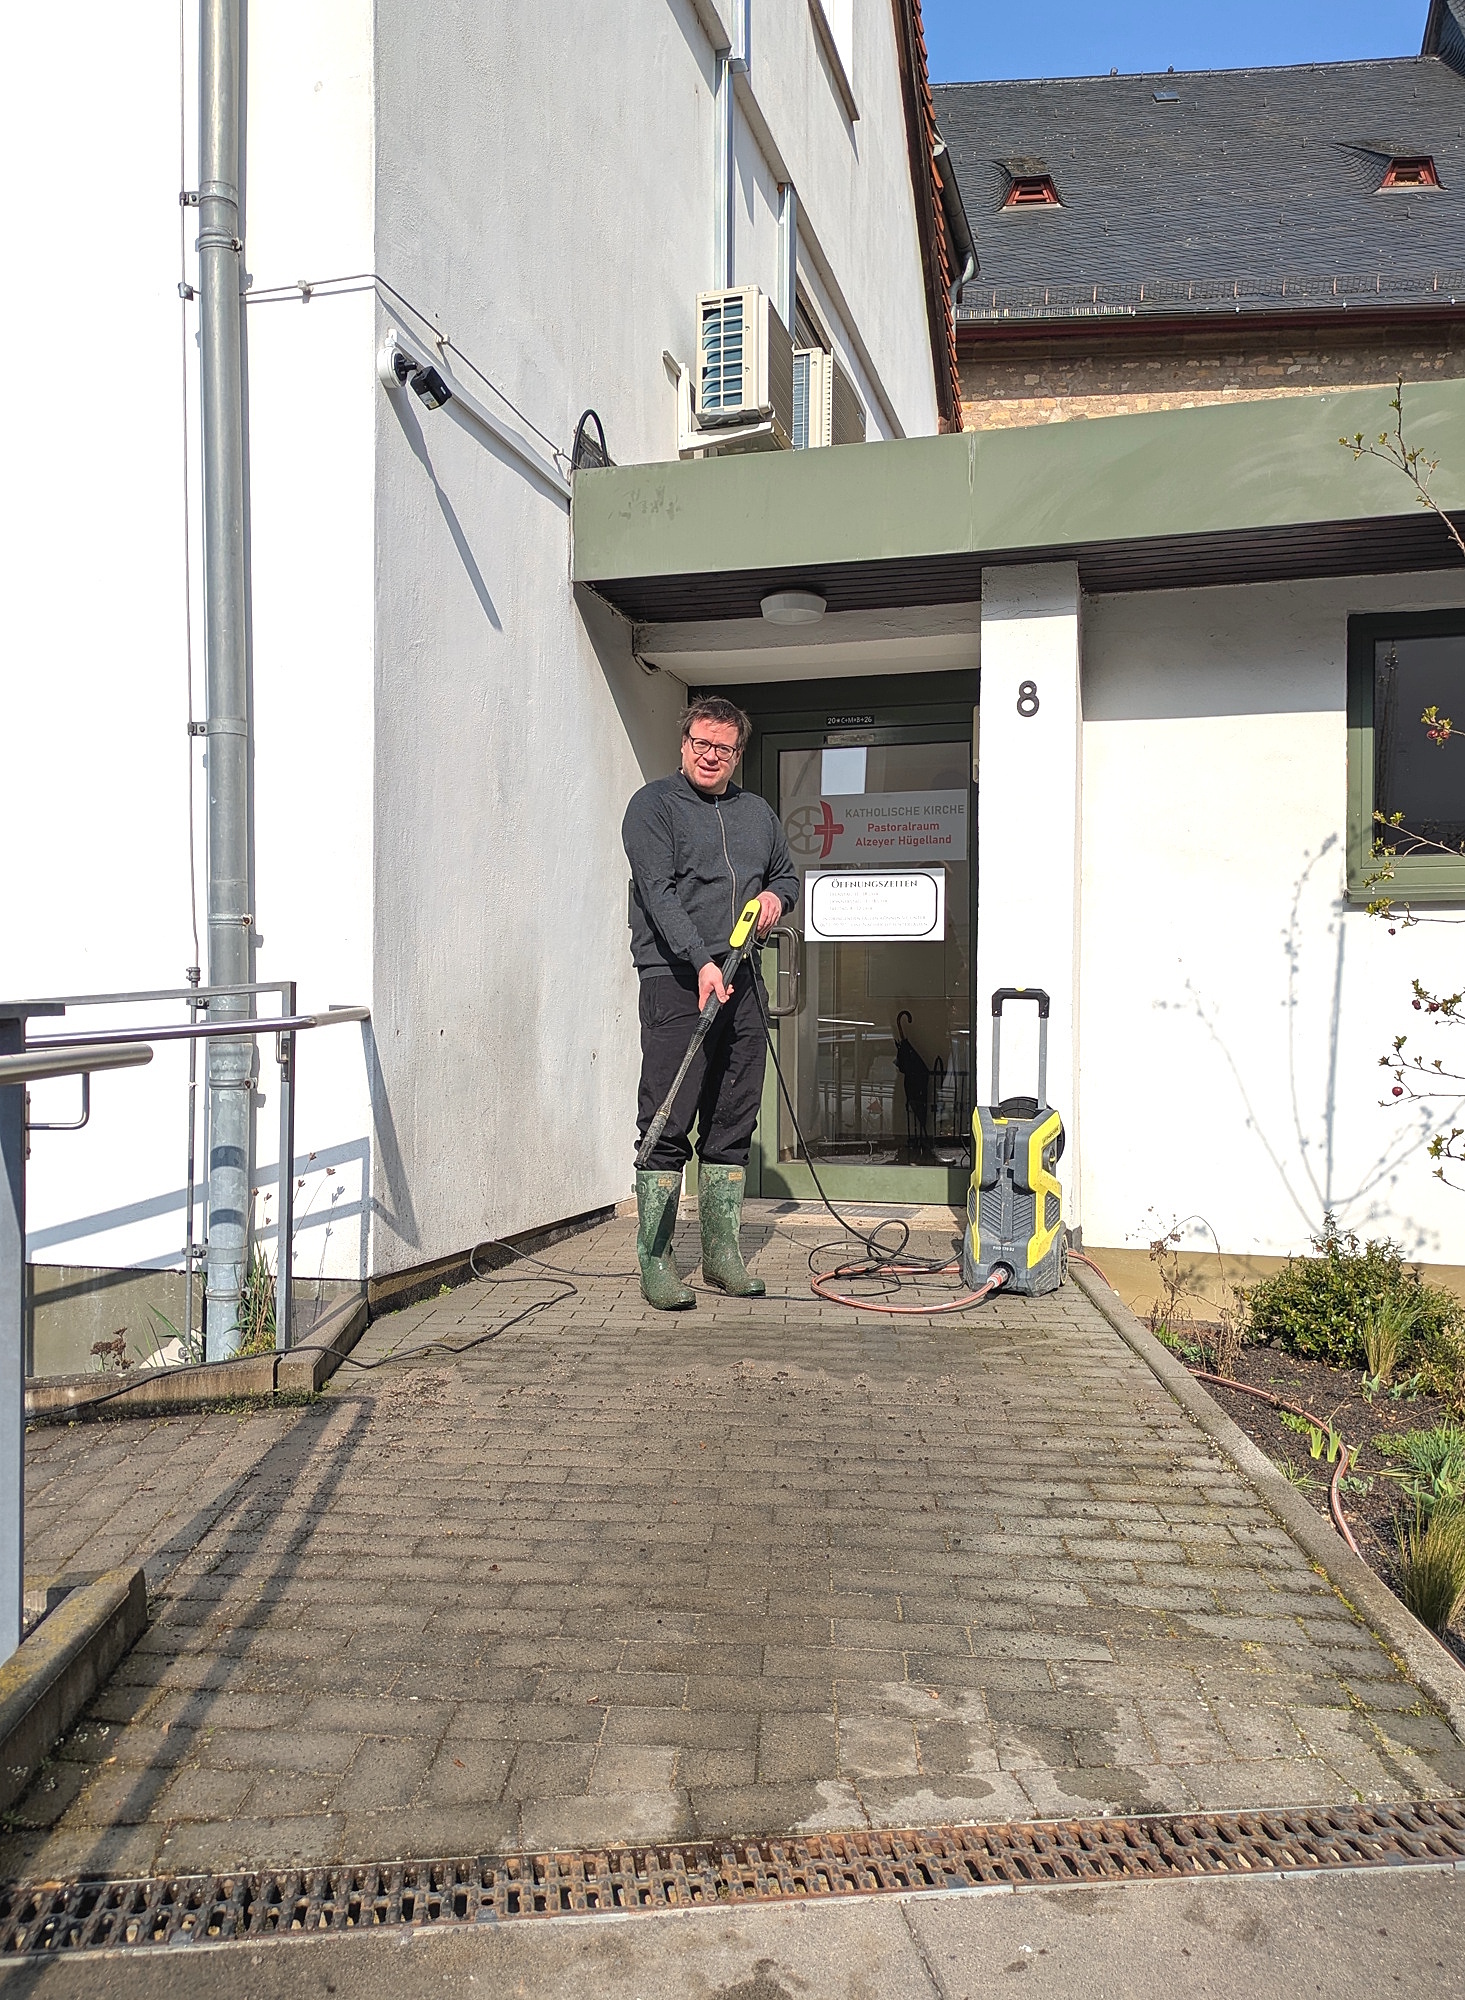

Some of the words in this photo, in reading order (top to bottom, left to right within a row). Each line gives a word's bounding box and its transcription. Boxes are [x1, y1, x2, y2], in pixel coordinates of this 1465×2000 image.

[1017, 680, 1040, 717] 8
[845, 806, 920, 818] KATHOLISCHE
[923, 804, 965, 816] KIRCHE
[867, 821, 940, 833] Pastoralraum
[855, 837, 895, 848] Alzeyer
[898, 834, 952, 847] Hügelland
